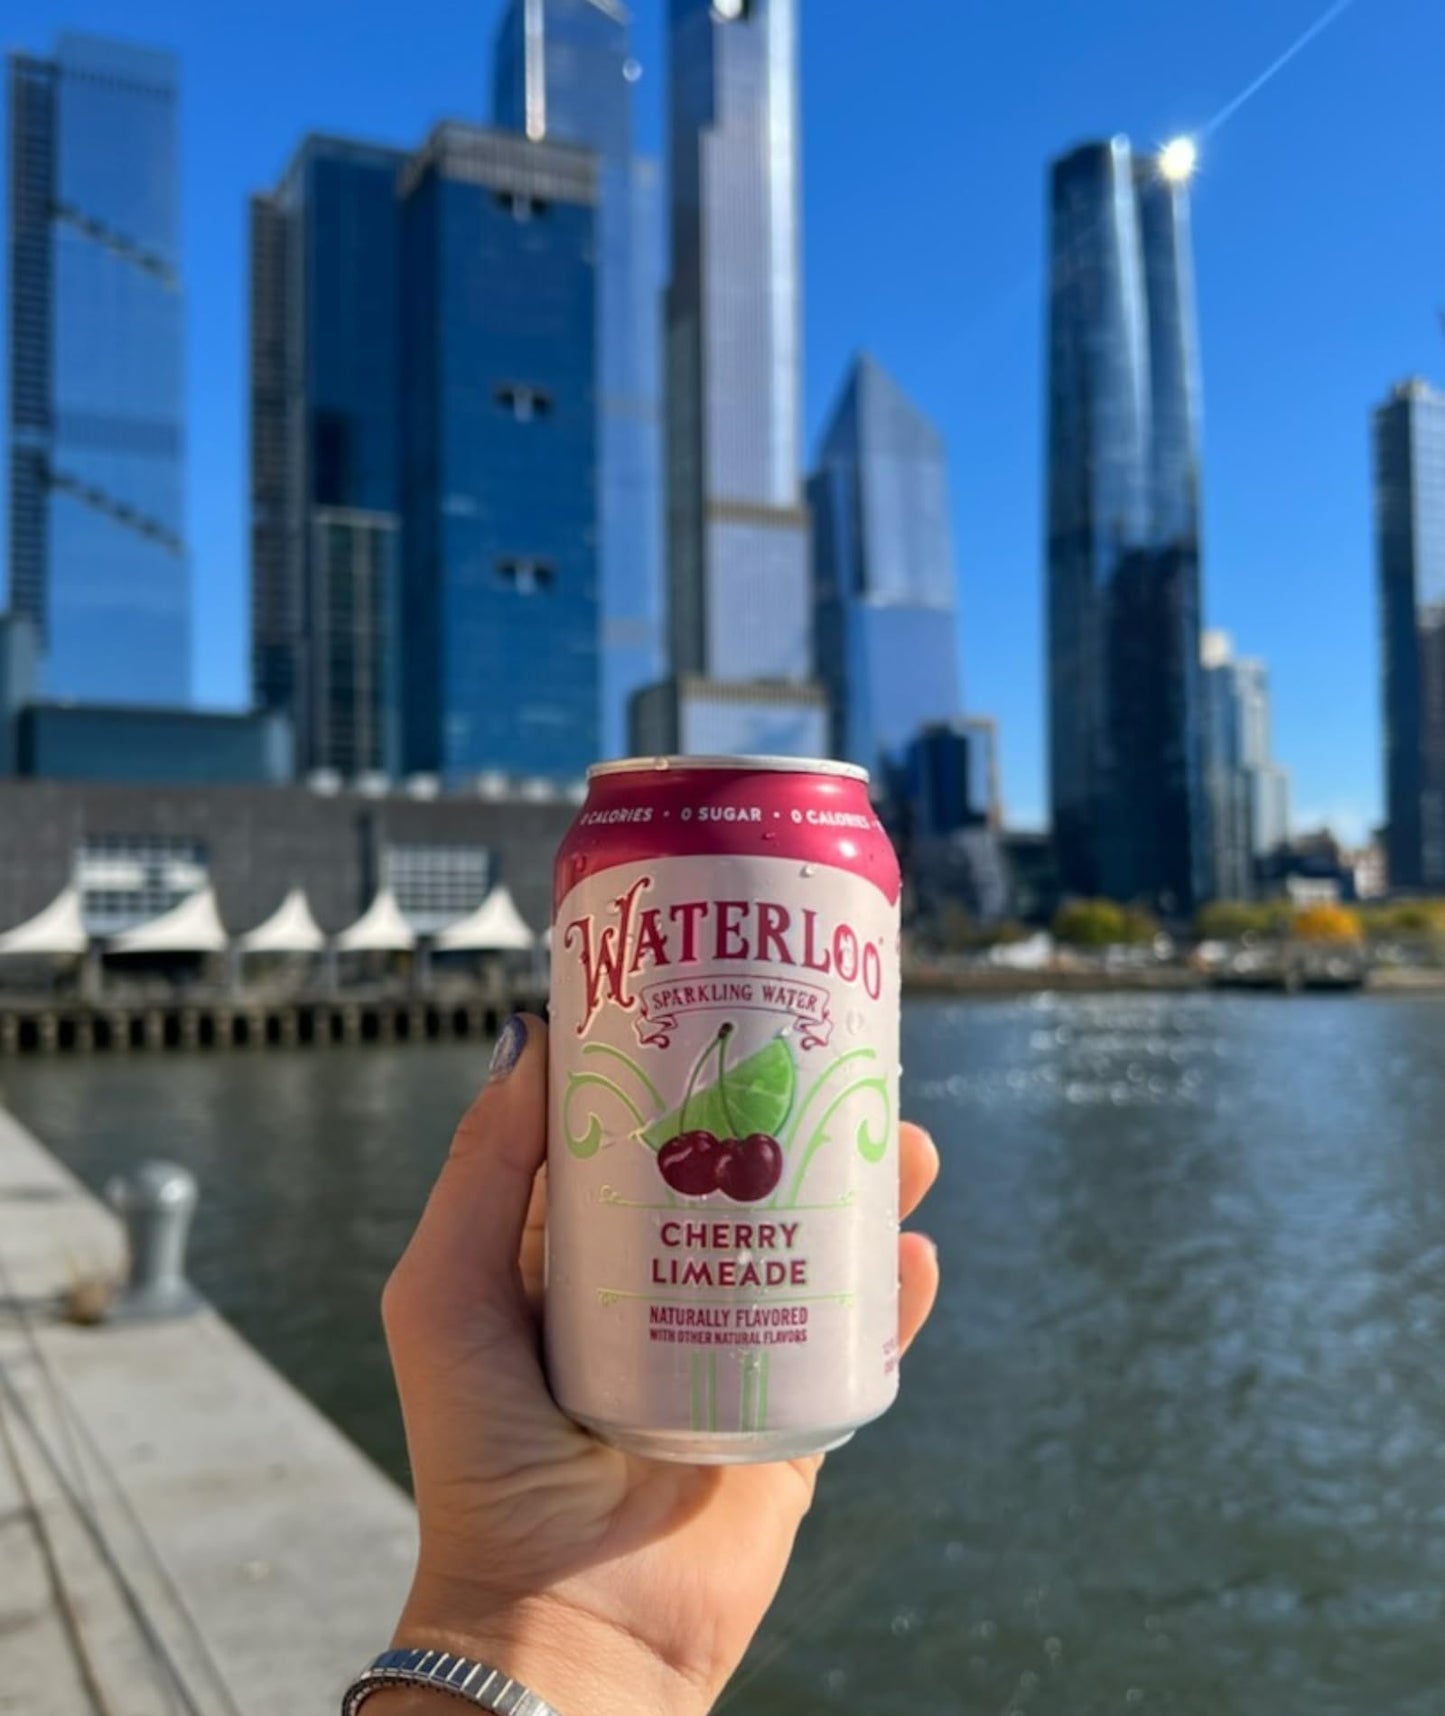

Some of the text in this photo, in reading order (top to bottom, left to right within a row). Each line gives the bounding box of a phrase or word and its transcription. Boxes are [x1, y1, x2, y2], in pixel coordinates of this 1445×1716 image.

[588, 808, 653, 825] CALORIES
[681, 808, 692, 821] 0
[698, 807, 762, 821] SUGAR
[791, 809, 802, 824] 0
[806, 809, 871, 829] CALORIES
[565, 877, 881, 1034] WATERLOO
[652, 984, 818, 1012] SPARKLING WATER
[660, 1222, 799, 1249] CHERRY
[652, 1259, 808, 1287] LIMEADE
[650, 1306, 808, 1327] NATURALLY FLAVORED
[650, 1329, 808, 1345] WITH OTHER NATURAL FLAVORS
